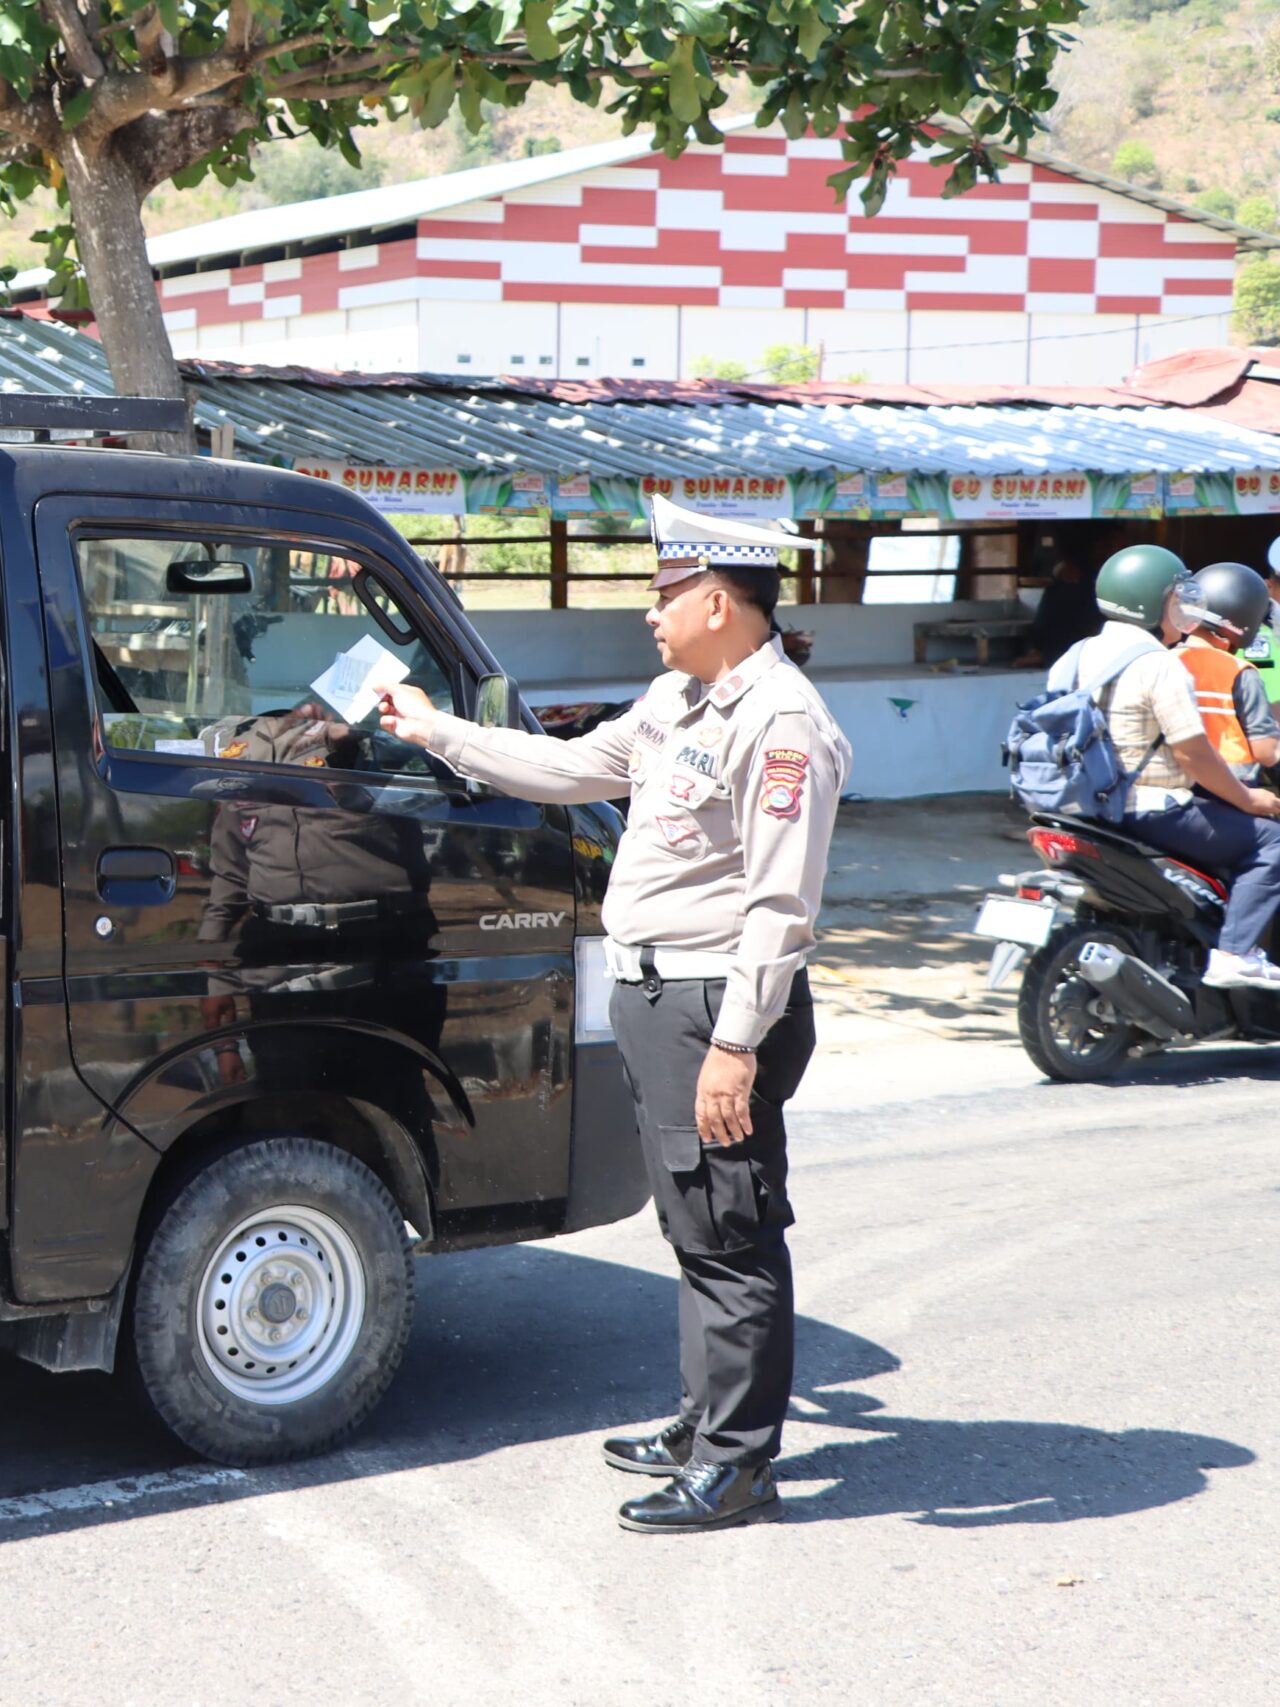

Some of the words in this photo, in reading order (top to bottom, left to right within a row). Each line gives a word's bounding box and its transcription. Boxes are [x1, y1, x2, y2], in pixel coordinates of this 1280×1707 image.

[642, 477, 673, 498] BU
[951, 479, 982, 499] BU
[1236, 475, 1261, 496] BU
[675, 745, 716, 775] POLRI
[479, 911, 566, 931] CARRY
